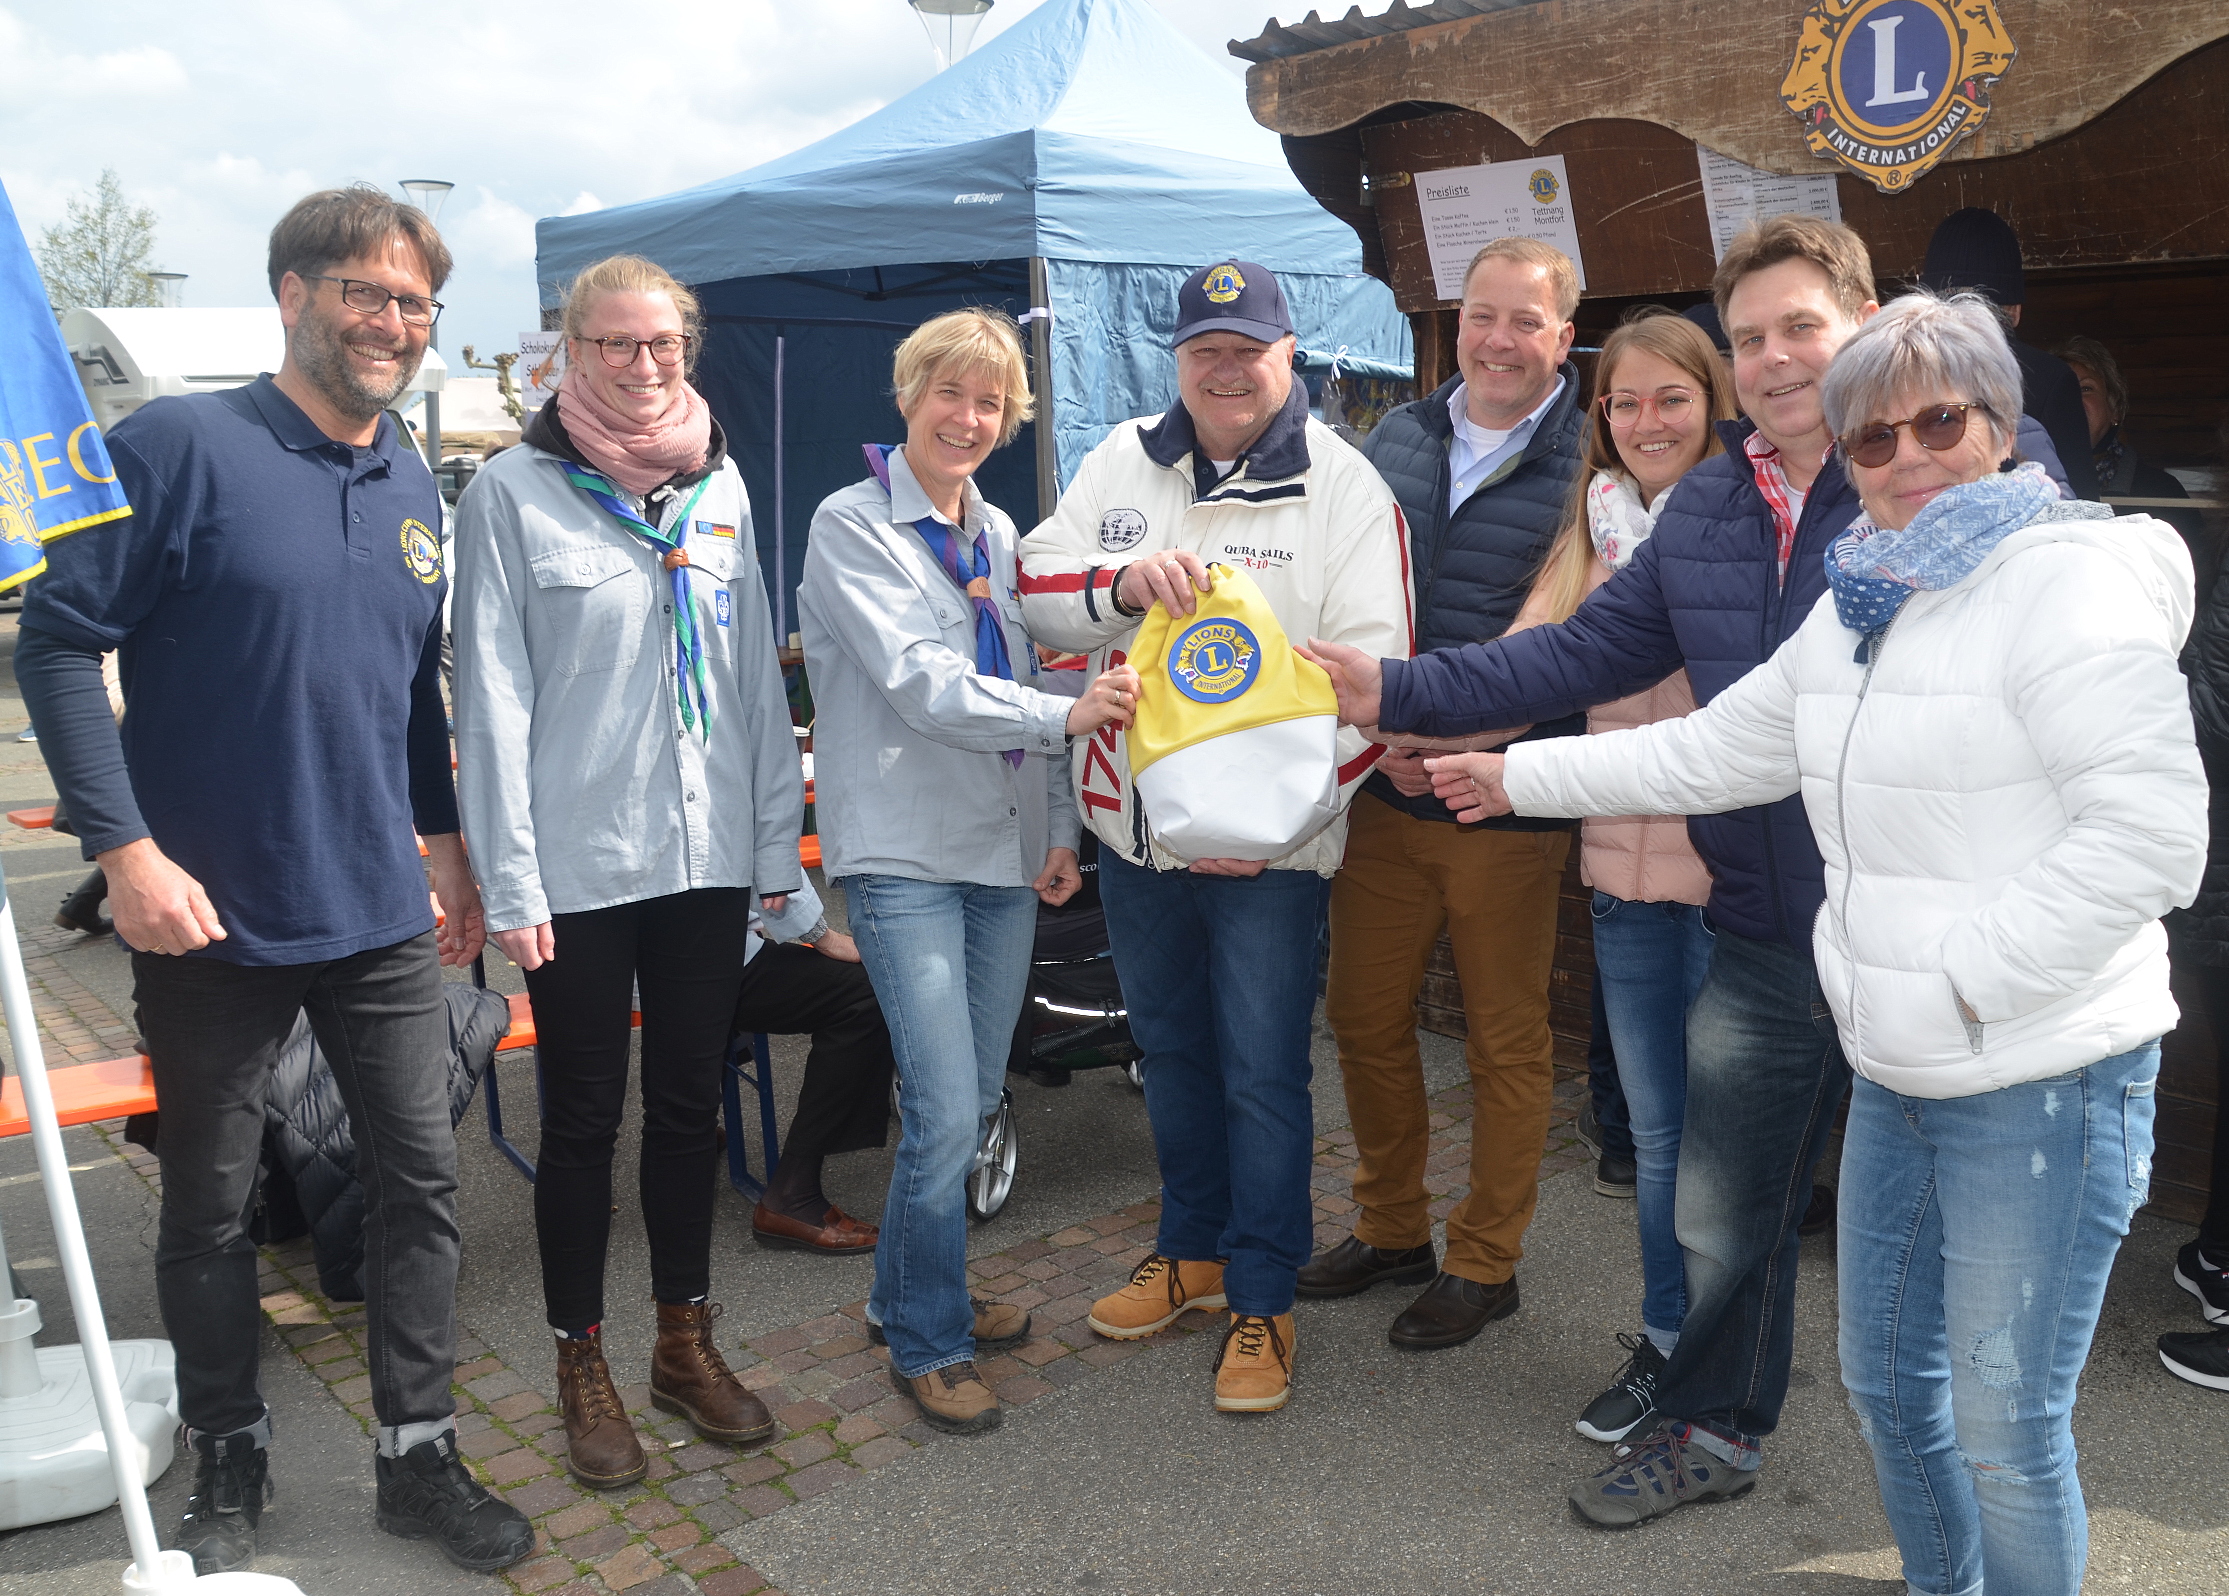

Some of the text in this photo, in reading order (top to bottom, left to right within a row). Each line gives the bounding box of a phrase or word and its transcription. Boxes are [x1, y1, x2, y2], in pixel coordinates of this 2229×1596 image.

[1865, 15, 1929, 107] L
[1827, 103, 1966, 165] INTERNATIONAL
[1426, 185, 1470, 198] Preisliste
[1532, 206, 1564, 216] Tettnang
[1534, 215, 1565, 225] Montfort
[1217, 276, 1229, 291] L
[1224, 544, 1294, 561] QUBA SAILS
[1244, 557, 1269, 569] X-10
[1187, 627, 1232, 647] LIONS
[1203, 646, 1229, 672] L
[1197, 672, 1242, 690] INTERNATIONAL
